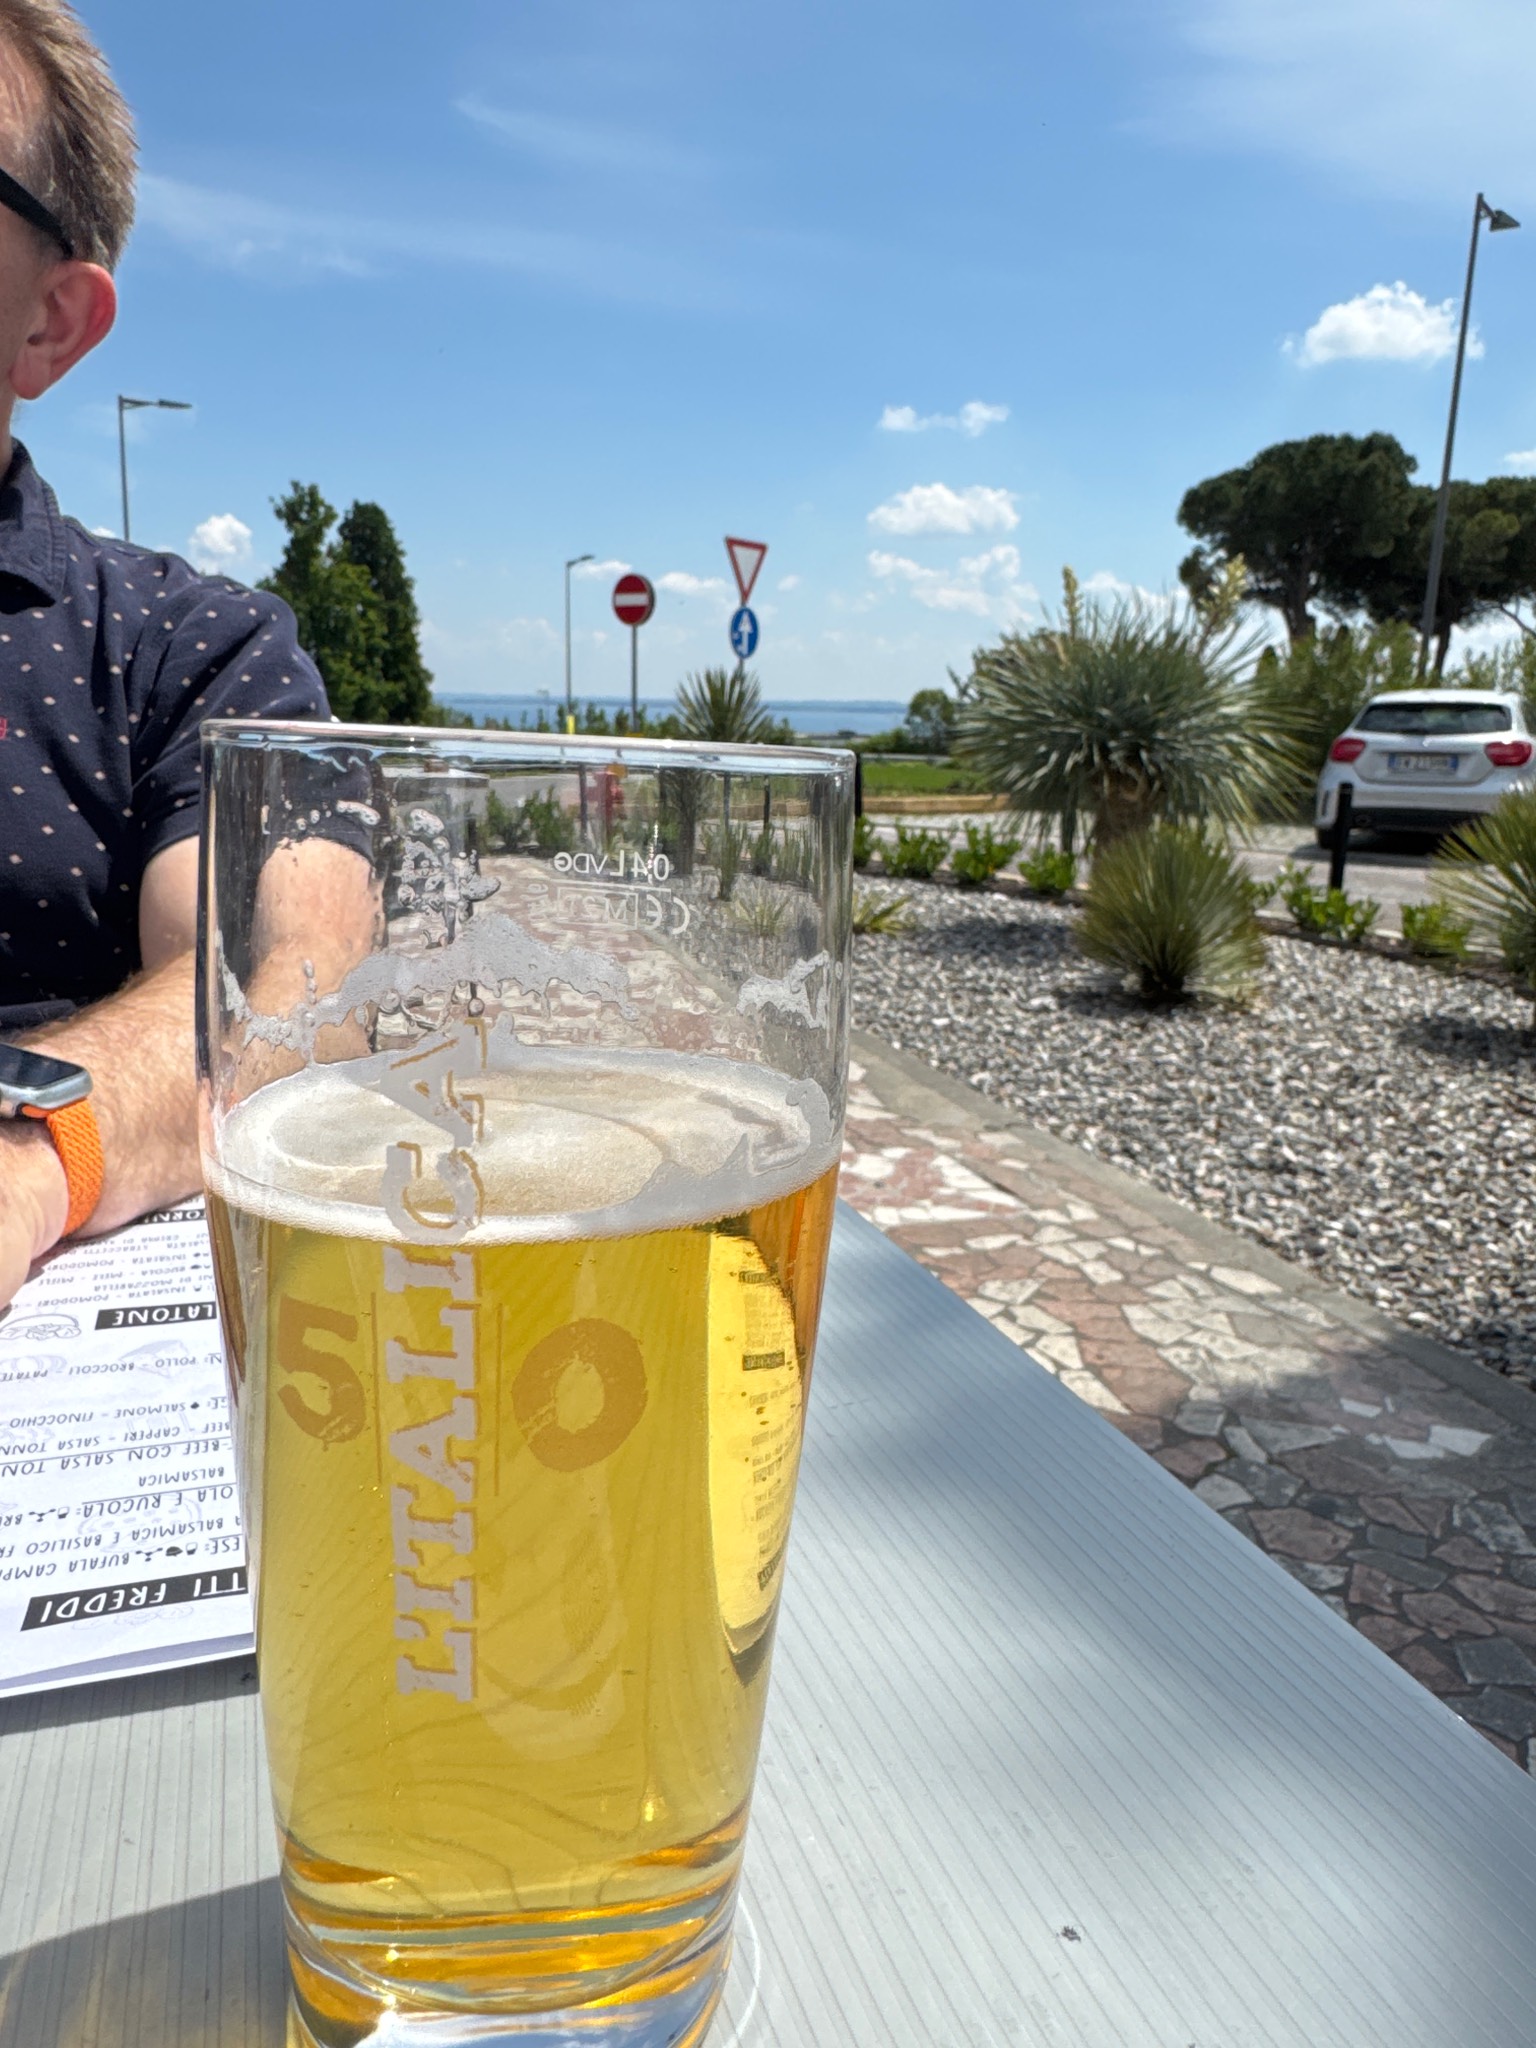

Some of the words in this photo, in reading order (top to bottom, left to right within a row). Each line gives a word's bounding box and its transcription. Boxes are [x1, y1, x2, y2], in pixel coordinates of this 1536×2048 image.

[38, 1293, 110, 1307] POMODORI
[112, 1304, 213, 1326] LATONE
[68, 1362, 135, 1376] BROCCOLI
[155, 1356, 197, 1368] POLLO
[114, 1402, 186, 1419] SALMONE
[9, 1411, 94, 1429] FINOCCHIO
[58, 1435, 100, 1451] SALSA
[124, 1426, 180, 1442] CAPPERI
[60, 1452, 114, 1470] SALSA
[127, 1445, 171, 1461] CON
[1, 1461, 46, 1477] TON
[138, 1466, 224, 1487] BALSAMICA
[174, 1491, 182, 1506] E
[197, 1485, 233, 1503] OLA
[113, 1531, 120, 1545] E
[131, 1518, 224, 1541] BALSAMICA
[26, 1534, 102, 1555] BASILICO
[69, 1552, 130, 1573] BUFALA
[0, 1563, 57, 1581] CAMP
[193, 1572, 246, 1598] TTI
[40, 1583, 166, 1623] FREDDI
